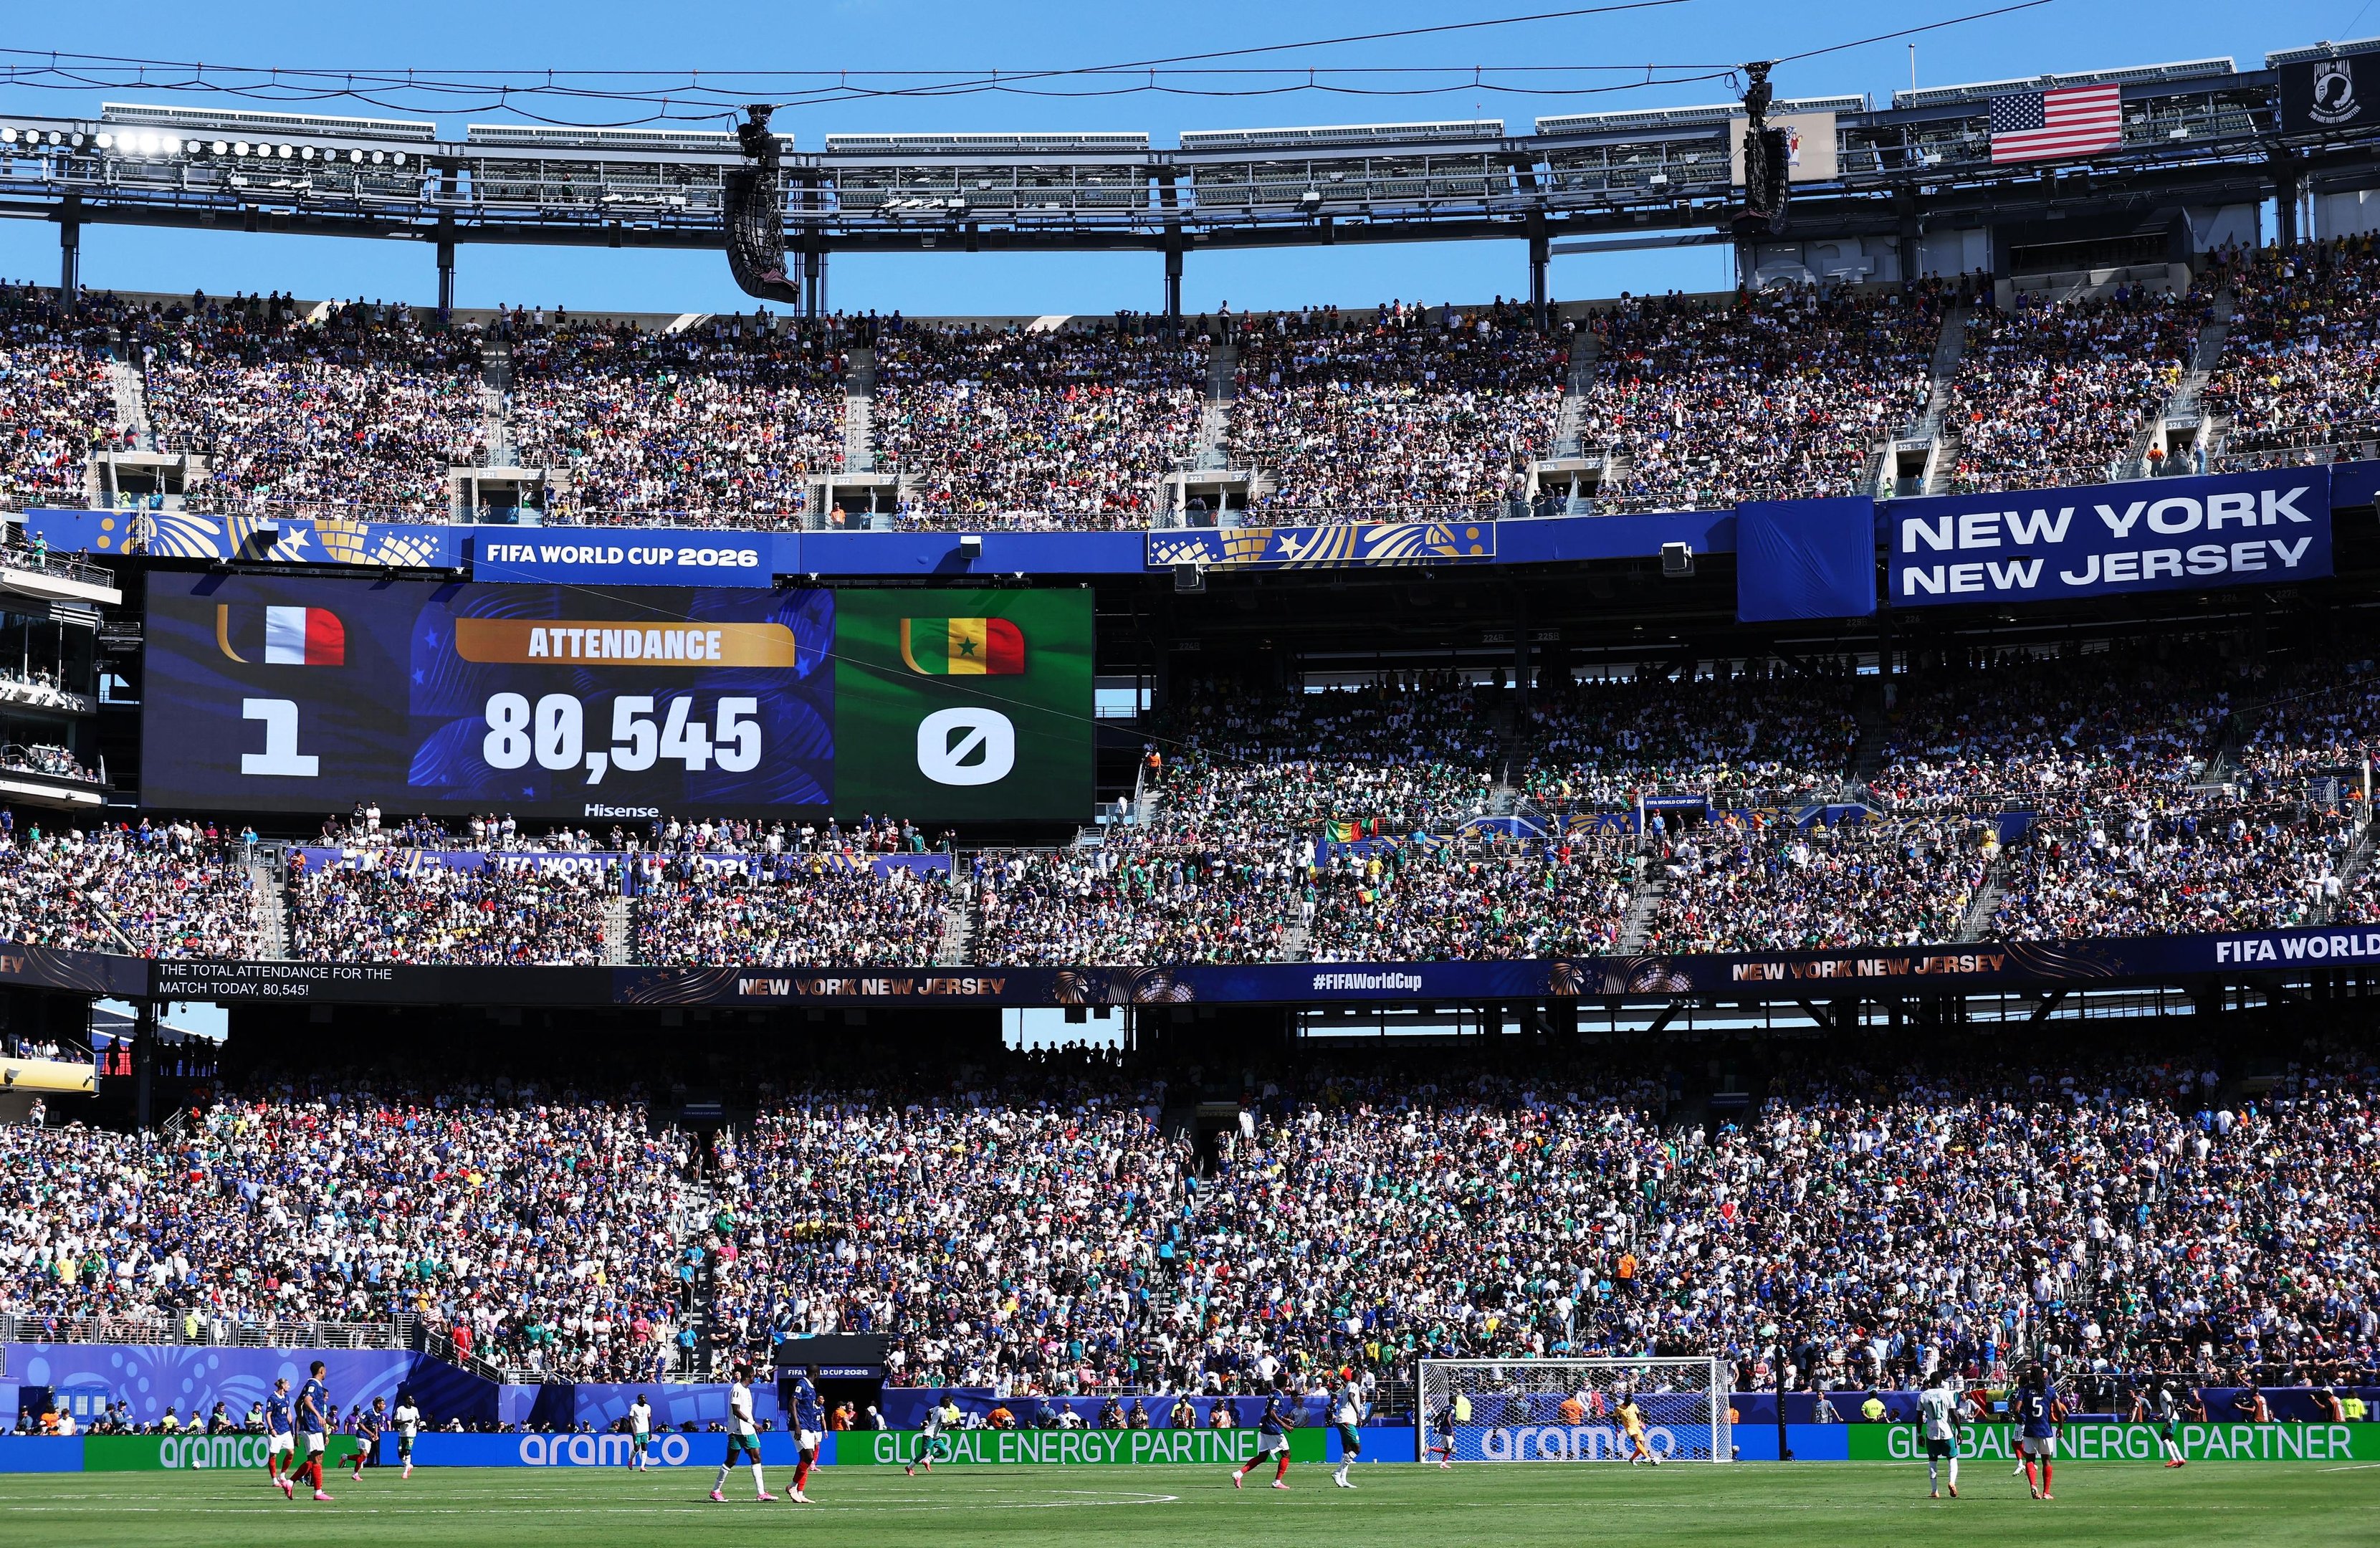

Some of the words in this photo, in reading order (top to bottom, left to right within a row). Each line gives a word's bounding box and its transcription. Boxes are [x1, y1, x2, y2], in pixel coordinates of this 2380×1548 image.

[2314, 62, 2331, 86] POW
[2336, 59, 2352, 81] MIA
[1902, 507, 2075, 553] NEW
[2093, 487, 2312, 538] YORK
[489, 547, 535, 564] FIFA
[539, 547, 623, 565] WORLD
[627, 547, 674, 566] CUP
[677, 547, 758, 568] 2026
[1903, 558, 2045, 596] NEW
[2060, 536, 2313, 586] JERSEY
[528, 628, 722, 661] ATTENDANCE
[242, 698, 320, 777] 1
[483, 692, 763, 785] 80,545
[917, 707, 1015, 786] 0
[584, 803, 659, 818] Hisense
[2216, 940, 2275, 962] FIFA
[2280, 934, 2380, 960] WORLD
[160, 965, 187, 975] THE
[191, 965, 234, 977] TOTAL
[236, 965, 328, 979] ATTENDANCE
[333, 967, 362, 980] FOR
[365, 968, 392, 980] THE
[1732, 962, 1785, 981] NEW
[1789, 960, 1853, 978] YORK
[1857, 958, 1910, 977] NEW
[1914, 954, 2005, 975] JERSEY
[160, 982, 208, 994] MATCH
[212, 983, 259, 996] TODAY,
[263, 984, 309, 997] 80,545!
[739, 979, 790, 995] NEW
[796, 979, 856, 995] YORK
[861, 979, 914, 995] NEW
[918, 978, 1006, 995] JERSEY
[1312, 972, 1423, 993] #FIFAWorldCup
[2032, 1396, 2043, 1418] 5
[160, 1435, 269, 1469] aramco
[999, 1431, 1124, 1463] ENERGY
[1132, 1430, 1279, 1462] PARTNE
[1888, 1425, 2023, 1460] GLBAL
[2052, 1425, 2166, 1459] NERGY
[2184, 1424, 2353, 1459] PARTNER
